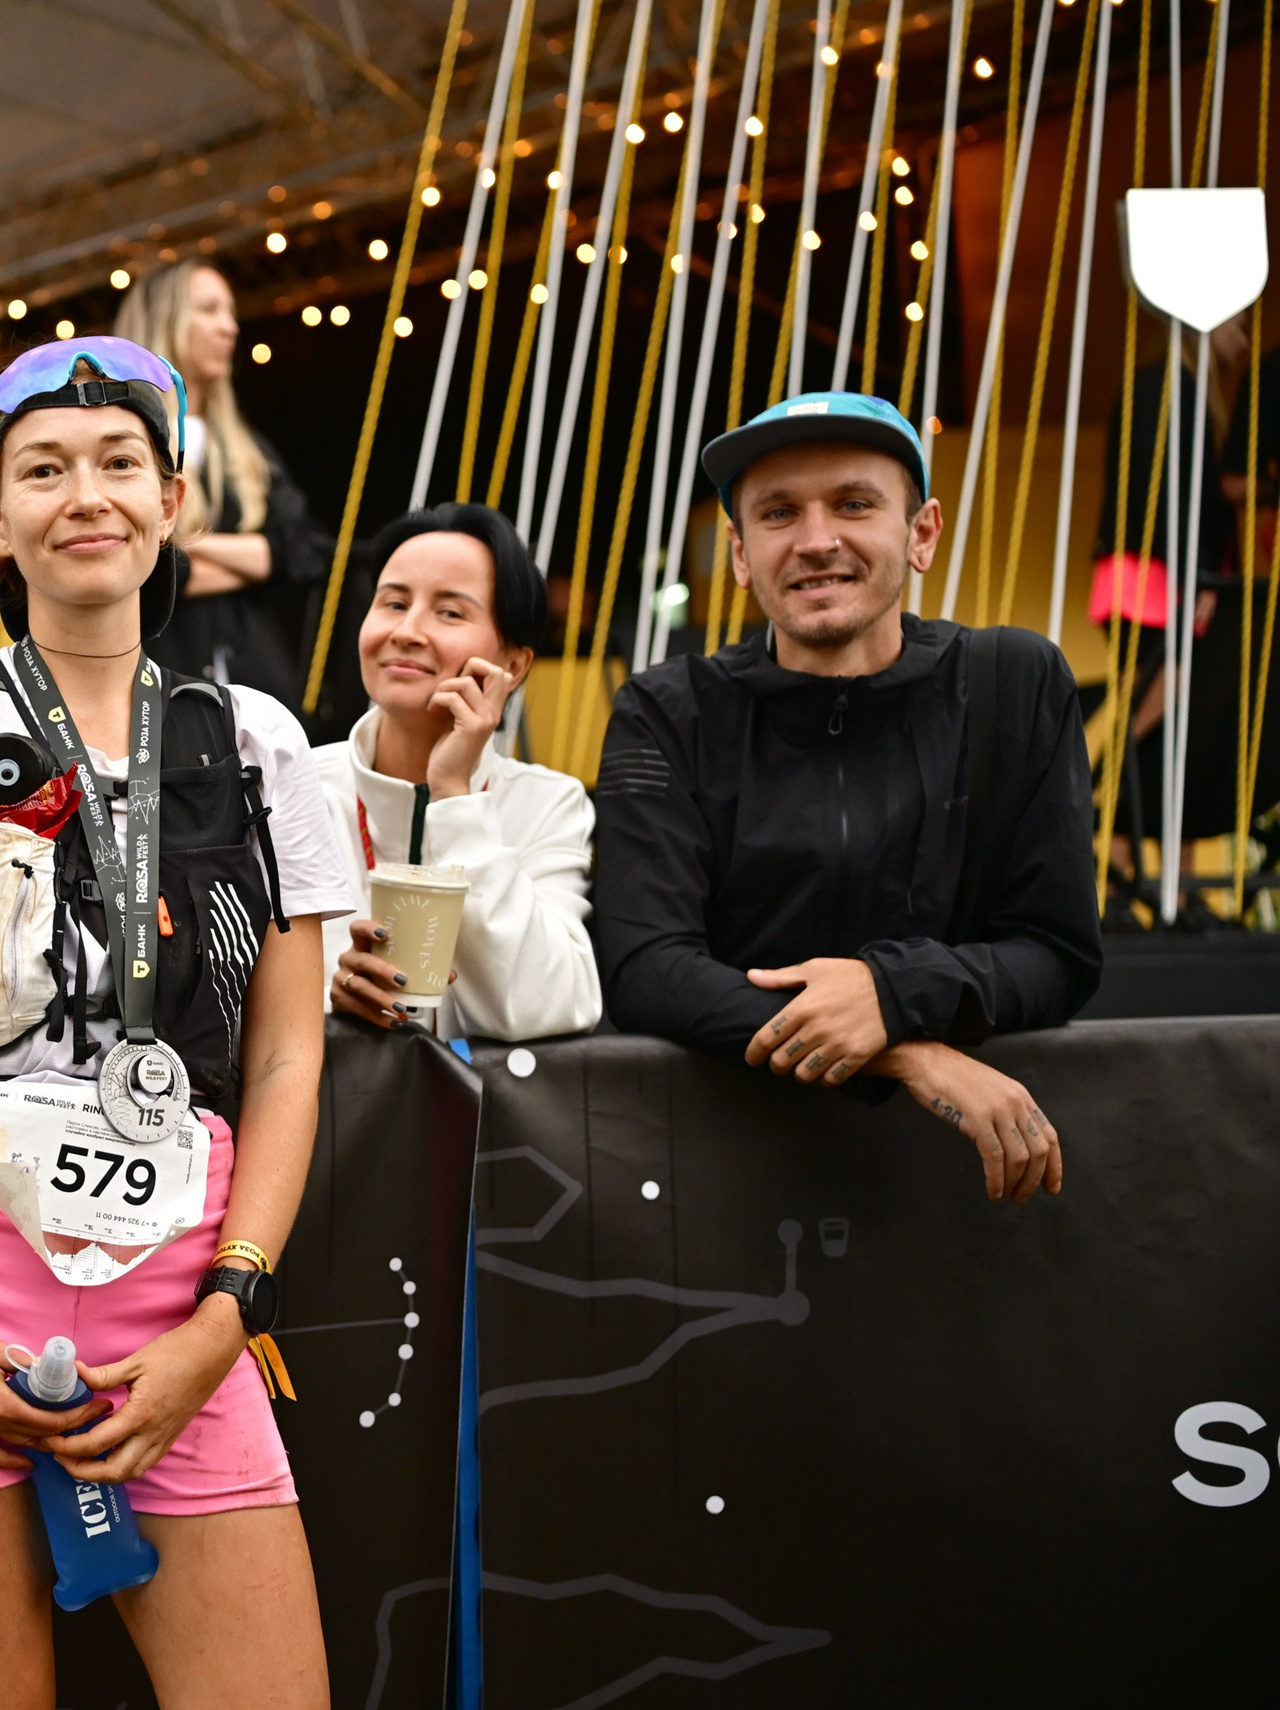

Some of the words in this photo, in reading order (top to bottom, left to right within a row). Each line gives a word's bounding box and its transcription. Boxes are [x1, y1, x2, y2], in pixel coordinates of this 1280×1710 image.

[23, 646, 35, 667] РОЗА
[31, 666, 48, 691] ХУТОР
[142, 701, 150, 726] ХУТОР
[57, 722, 75, 750] БАНК
[141, 727, 149, 747] РОЗА
[77, 763, 97, 802] ROSA
[136, 859, 149, 903] ROSA
[137, 924, 146, 958] БАНК
[24, 1094, 56, 1106] ROSA
[930, 1097, 963, 1125] 4:20
[138, 1108, 165, 1127] 115
[50, 1143, 157, 1206] 579
[114, 1215, 126, 1223] 444
[127, 1217, 140, 1225] 925
[240, 1245, 260, 1258] РОЗА
[1171, 1400, 1280, 1508] S
[75, 1479, 111, 1538] ICE
[110, 1494, 121, 1523] OUTDOOR
